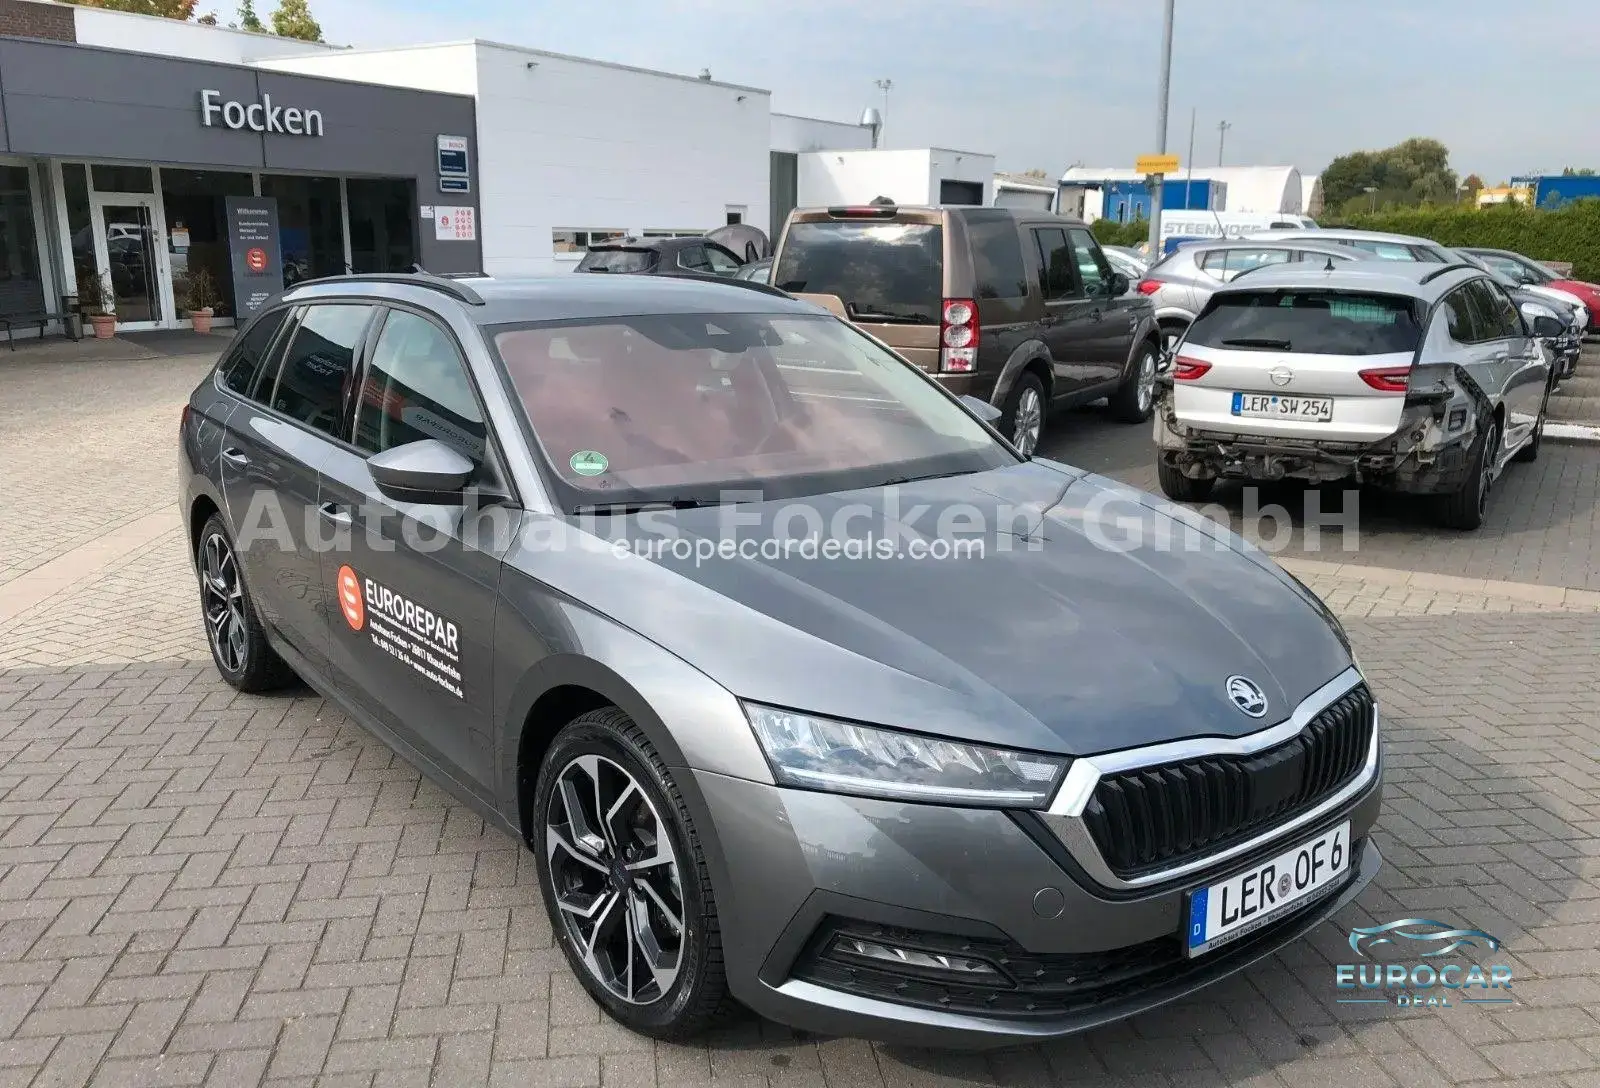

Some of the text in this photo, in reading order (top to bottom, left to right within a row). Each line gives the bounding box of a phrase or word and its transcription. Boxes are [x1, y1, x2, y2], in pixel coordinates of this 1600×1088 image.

[202, 89, 323, 136] Focken
[1242, 396, 1329, 416] LER SW 254
[584, 452, 594, 463] 4
[365, 578, 458, 652] EUROREPAR
[390, 630, 408, 649] Focken
[1220, 864, 1276, 927] LER
[1294, 839, 1326, 890] OF
[1331, 831, 1343, 870] 6
[1193, 923, 1201, 936] D
[1208, 931, 1239, 950] Autohaus
[1240, 921, 1262, 937] Focken
